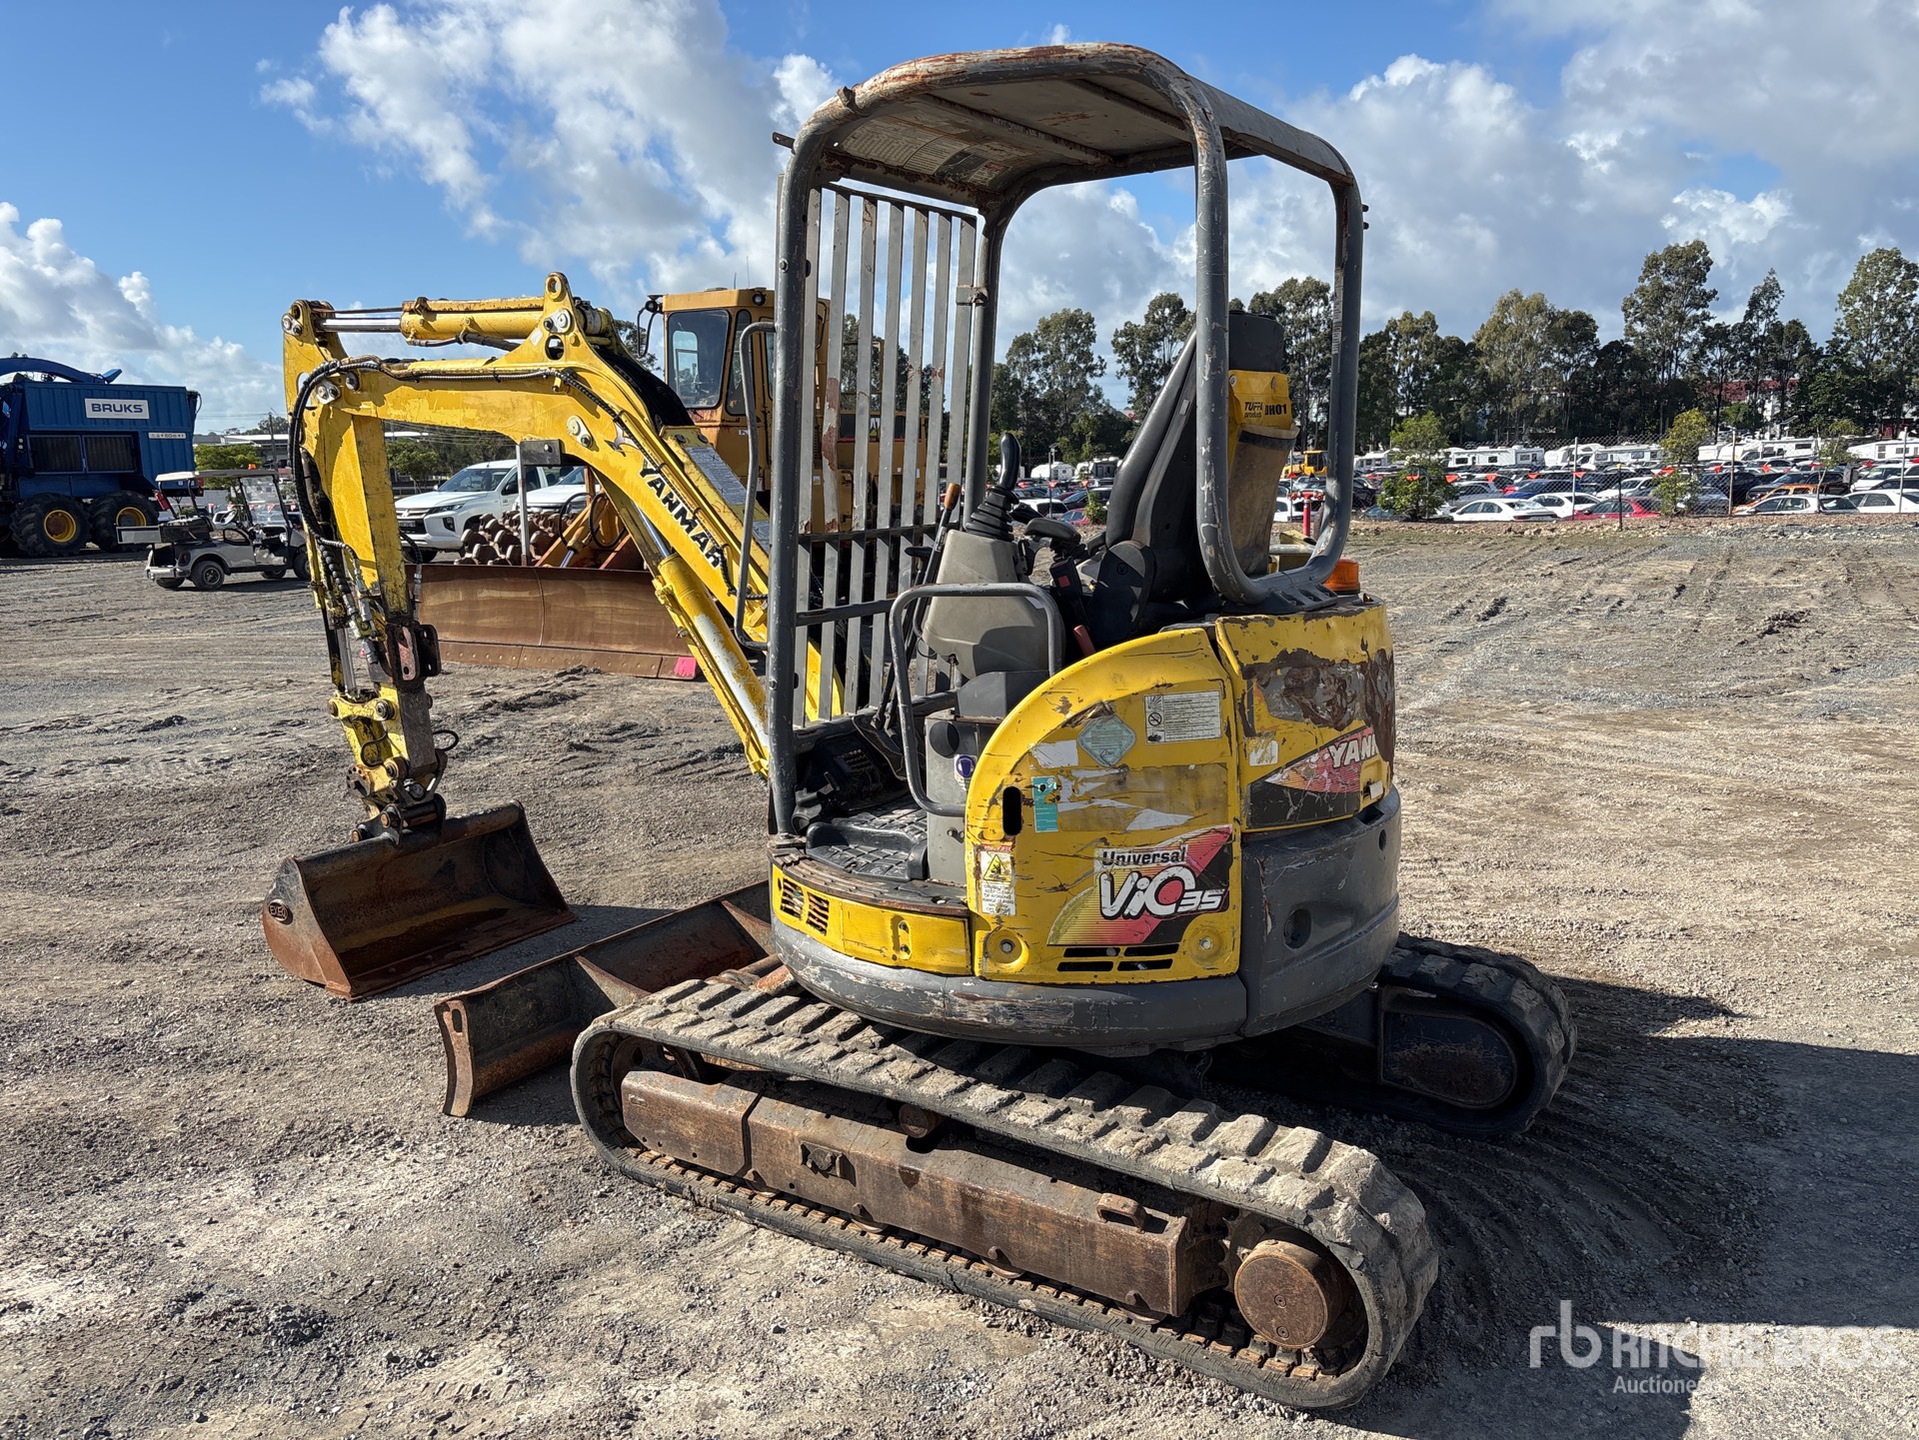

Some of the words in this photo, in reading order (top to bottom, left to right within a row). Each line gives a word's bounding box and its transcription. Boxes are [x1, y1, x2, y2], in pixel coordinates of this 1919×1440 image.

[91, 403, 143, 413] BRUKS
[640, 459, 722, 567] YANMAR
[1103, 847, 1187, 866] Universal
